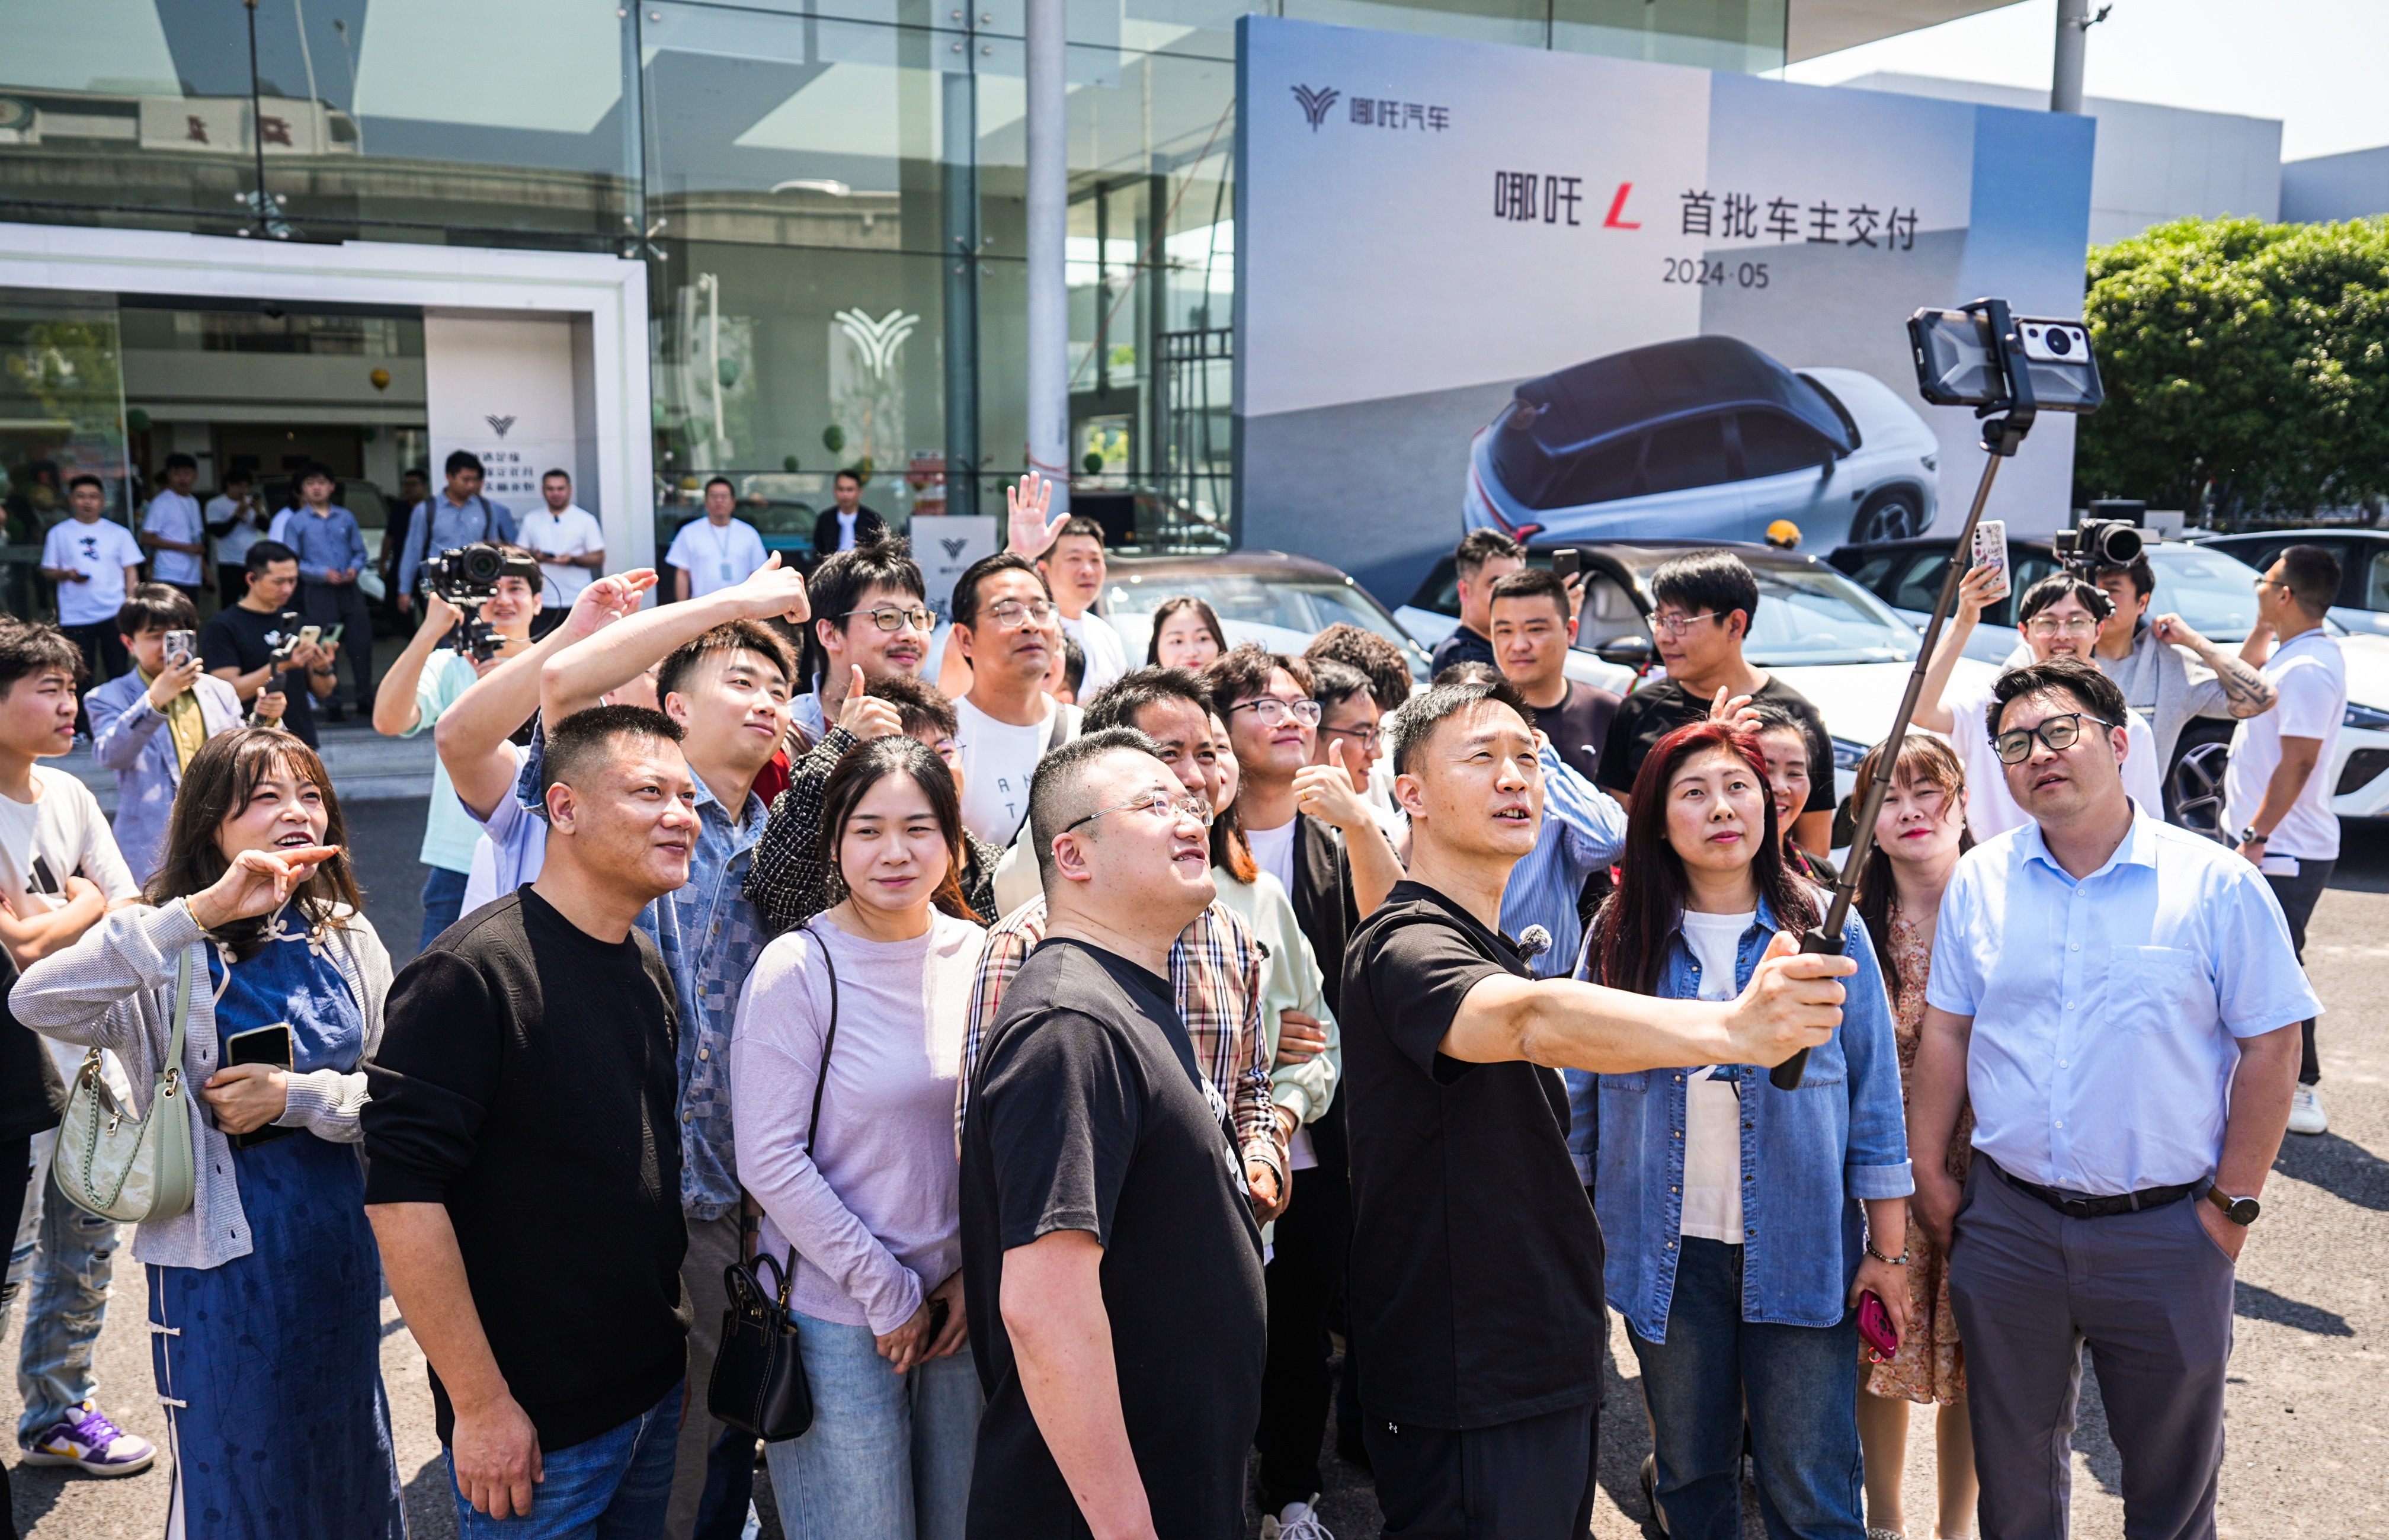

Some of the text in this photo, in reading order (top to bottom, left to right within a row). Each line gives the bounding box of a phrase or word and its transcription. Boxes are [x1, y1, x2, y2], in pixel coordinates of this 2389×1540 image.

[1350, 97, 1449, 132] 哪吒汽车
[1494, 171, 1919, 251] 哪吒 L 首批车主交付
